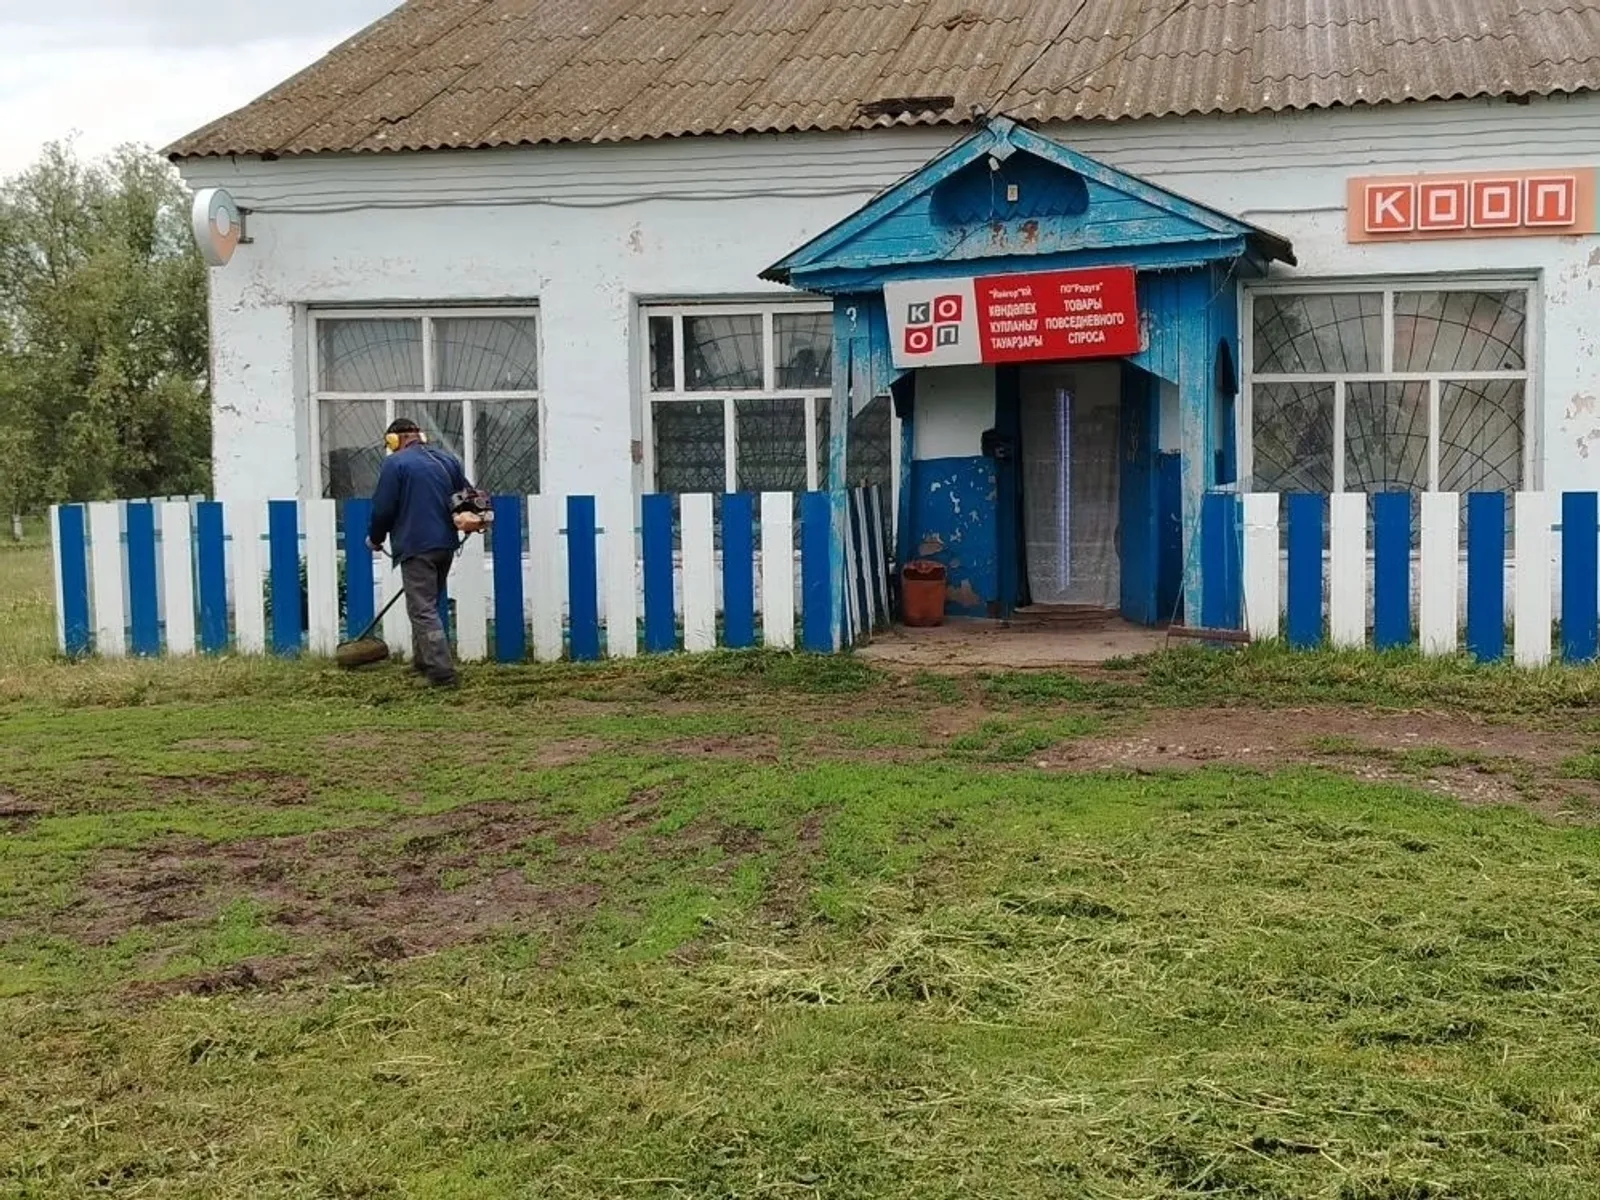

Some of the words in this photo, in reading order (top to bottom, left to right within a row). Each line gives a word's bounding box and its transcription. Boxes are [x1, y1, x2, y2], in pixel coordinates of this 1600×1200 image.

[1375, 184, 1566, 223] КООП
[1064, 297, 1103, 312] ТОВАРЫ
[1045, 312, 1125, 330] ПОВСЕДНЕВНОГО
[1068, 330, 1105, 344] СПРОСА
